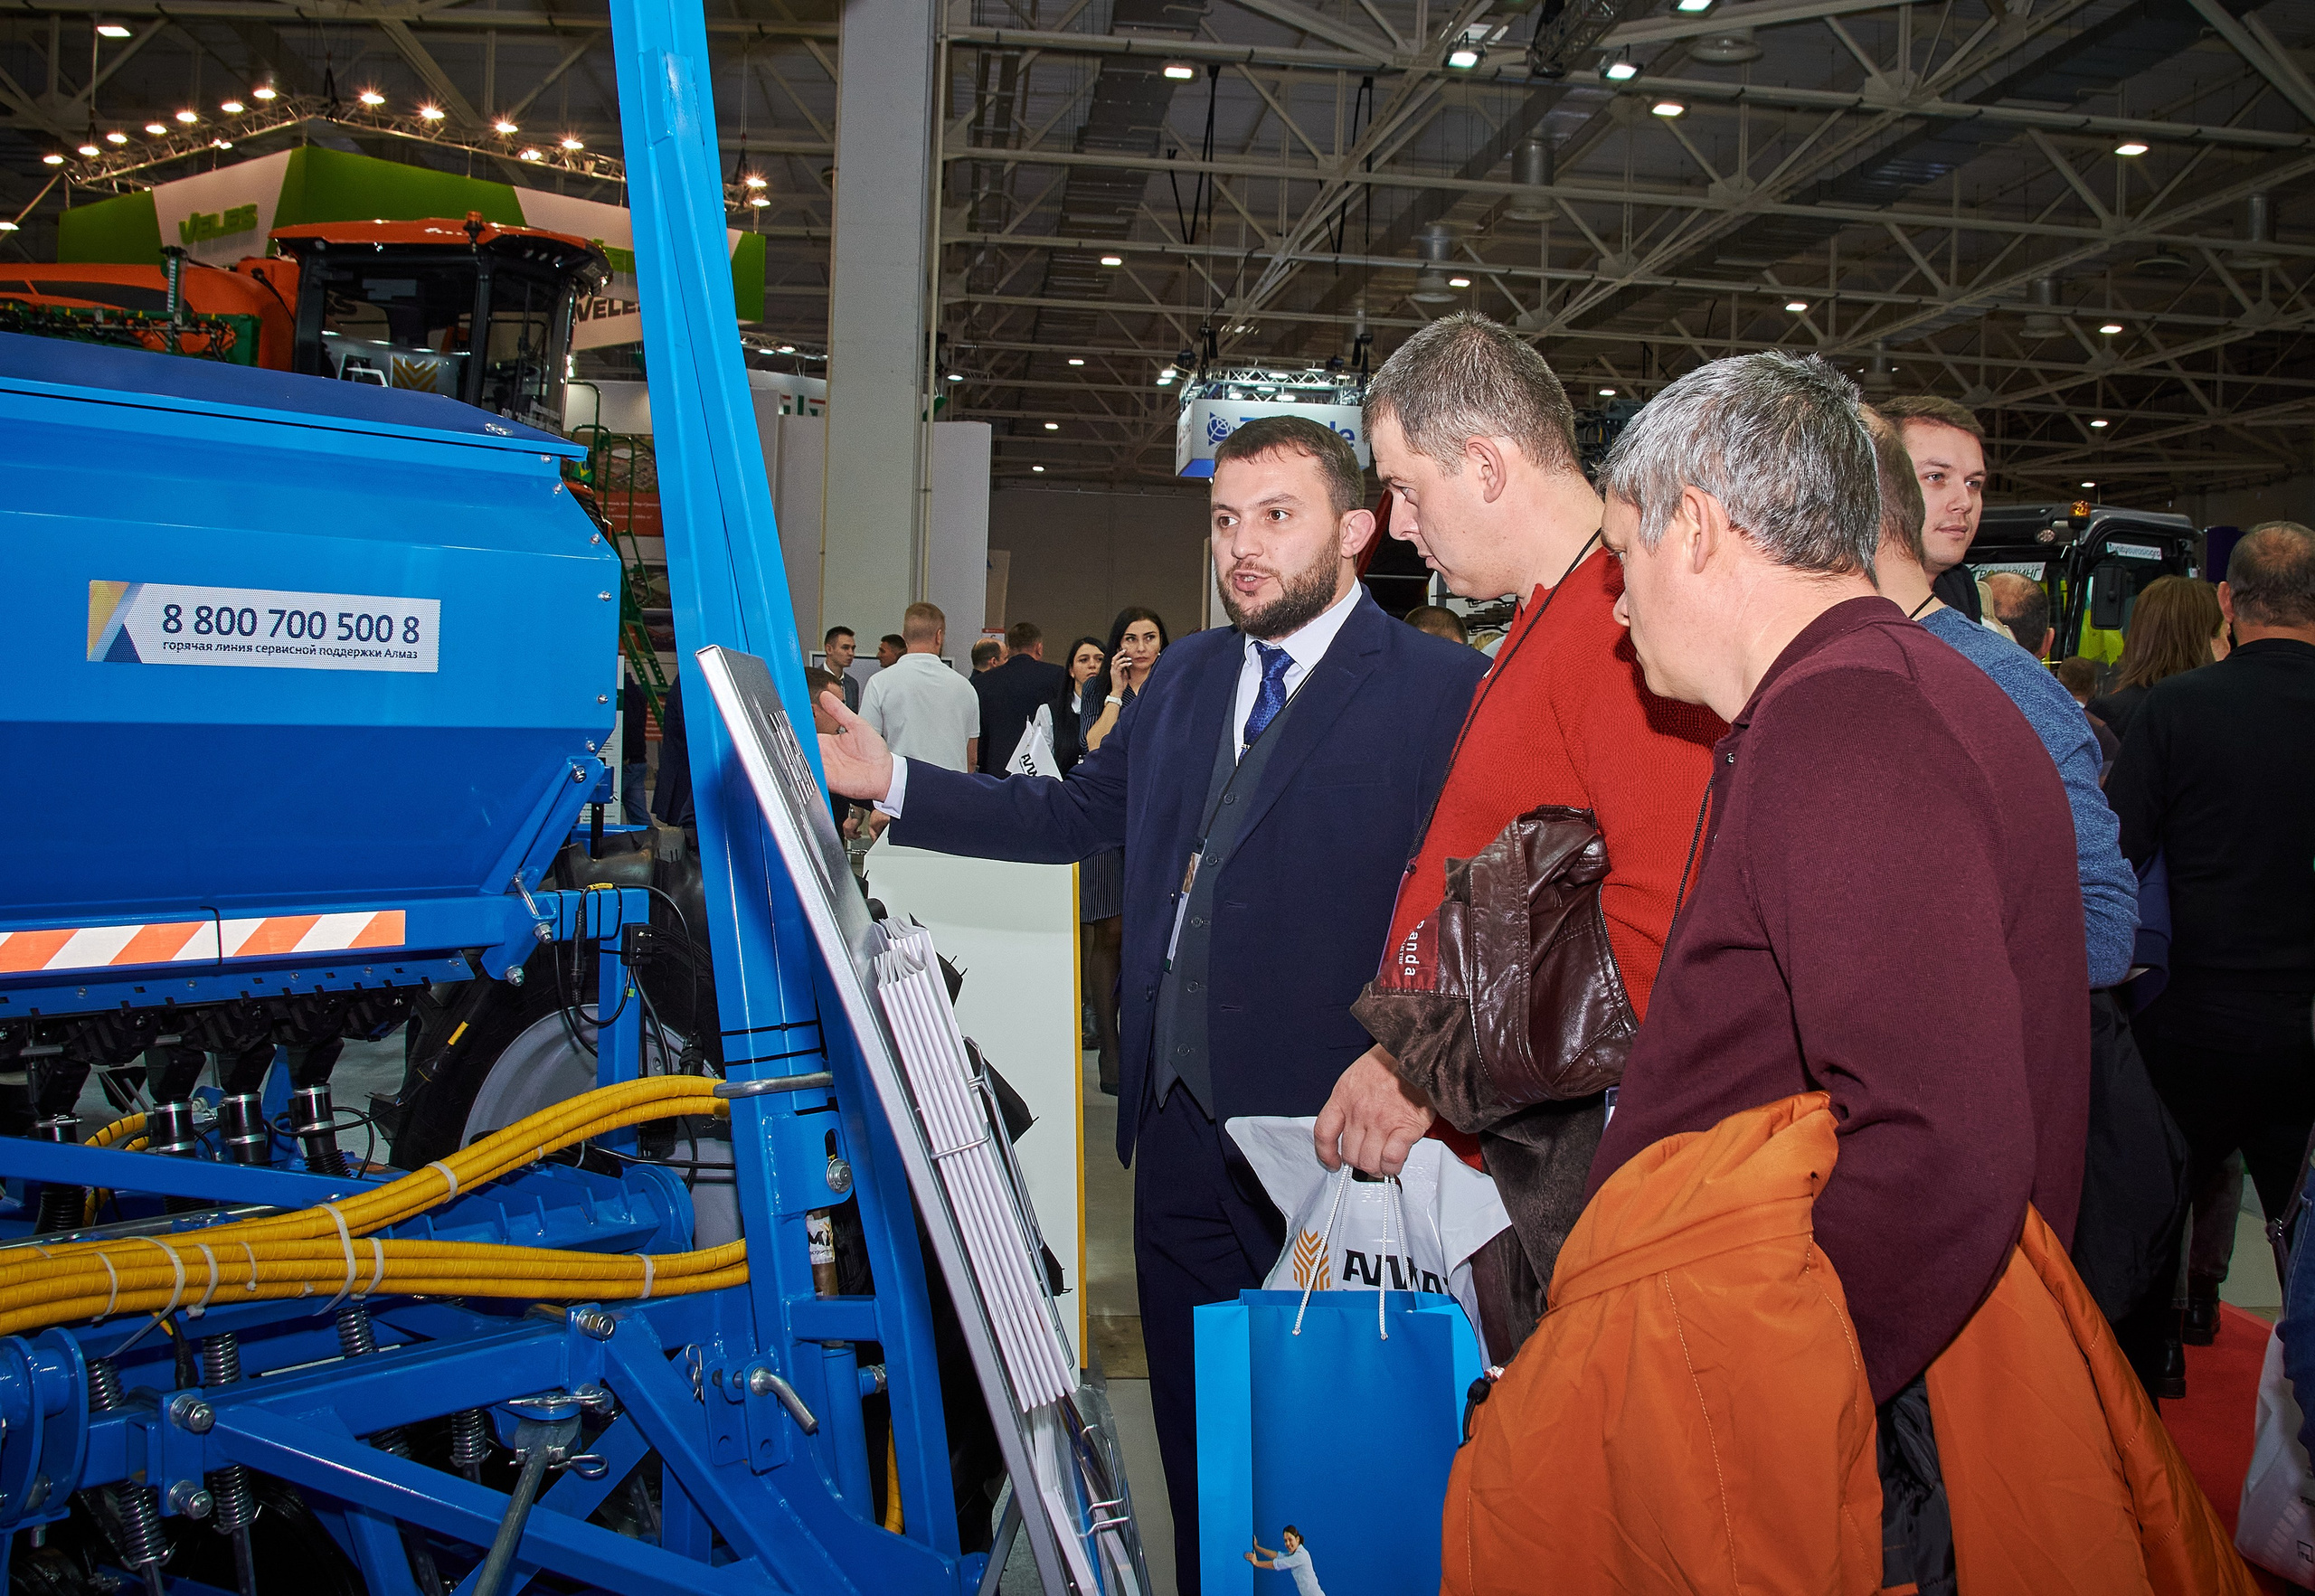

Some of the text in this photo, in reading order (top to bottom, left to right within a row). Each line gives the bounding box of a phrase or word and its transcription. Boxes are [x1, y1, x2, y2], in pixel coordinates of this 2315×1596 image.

[179, 203, 258, 245] VELES
[576, 297, 640, 322] VELE
[162, 603, 420, 644] 8 800 700 500 8
[163, 641, 418, 659] горячая линия сервисной поддержки Алмаз
